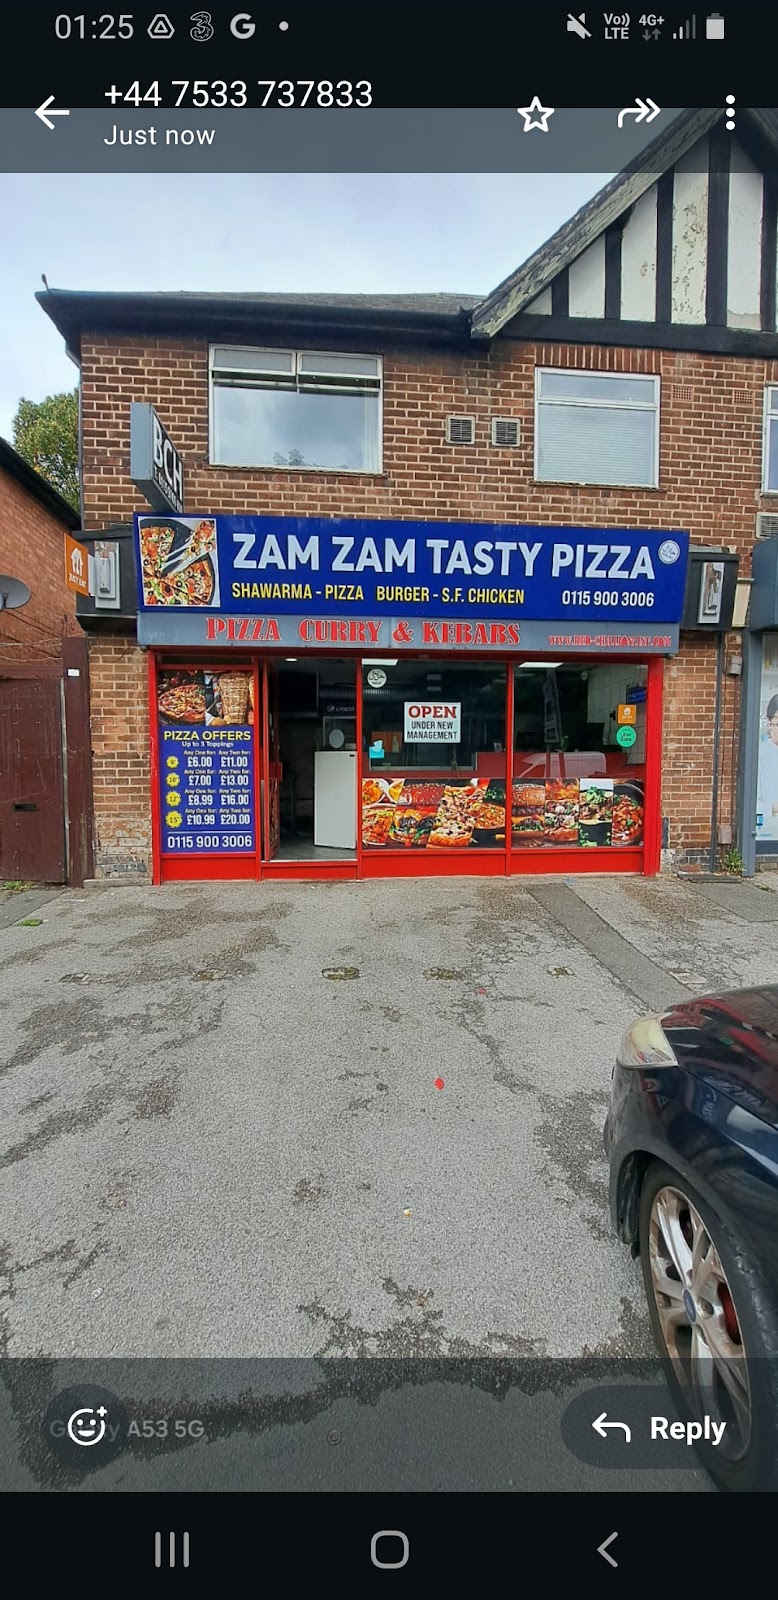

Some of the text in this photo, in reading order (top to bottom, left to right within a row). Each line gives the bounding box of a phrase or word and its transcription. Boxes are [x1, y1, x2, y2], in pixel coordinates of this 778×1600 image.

[153, 413, 182, 502] BCH
[232, 533, 655, 580] ZAM ZAM TASTY PIZZA
[231, 582, 313, 599] SHAWARMA
[325, 585, 364, 600] PIZZA
[376, 586, 430, 602] BURGER
[442, 587, 464, 603] S.F.
[468, 588, 524, 604] CHICKEN
[562, 590, 654, 607] 0115 900 3006
[206, 617, 520, 645] PIZZA CURRY & KEBABS
[408, 705, 457, 719] OPEN
[411, 721, 453, 730] UNDER NEW
[163, 730, 251, 741] PIZZA OFFERS
[407, 731, 457, 740] MANAGEMENT
[187, 756, 212, 767] £6.00
[221, 756, 248, 767] £11.00
[189, 775, 212, 786] £7.00
[221, 775, 249, 786] £13.00
[188, 795, 213, 805] £8.99
[221, 795, 249, 805] £16.00
[187, 814, 215, 825] £10.99
[221, 814, 250, 825] £20.00
[167, 835, 252, 848] 0115 900 3006
